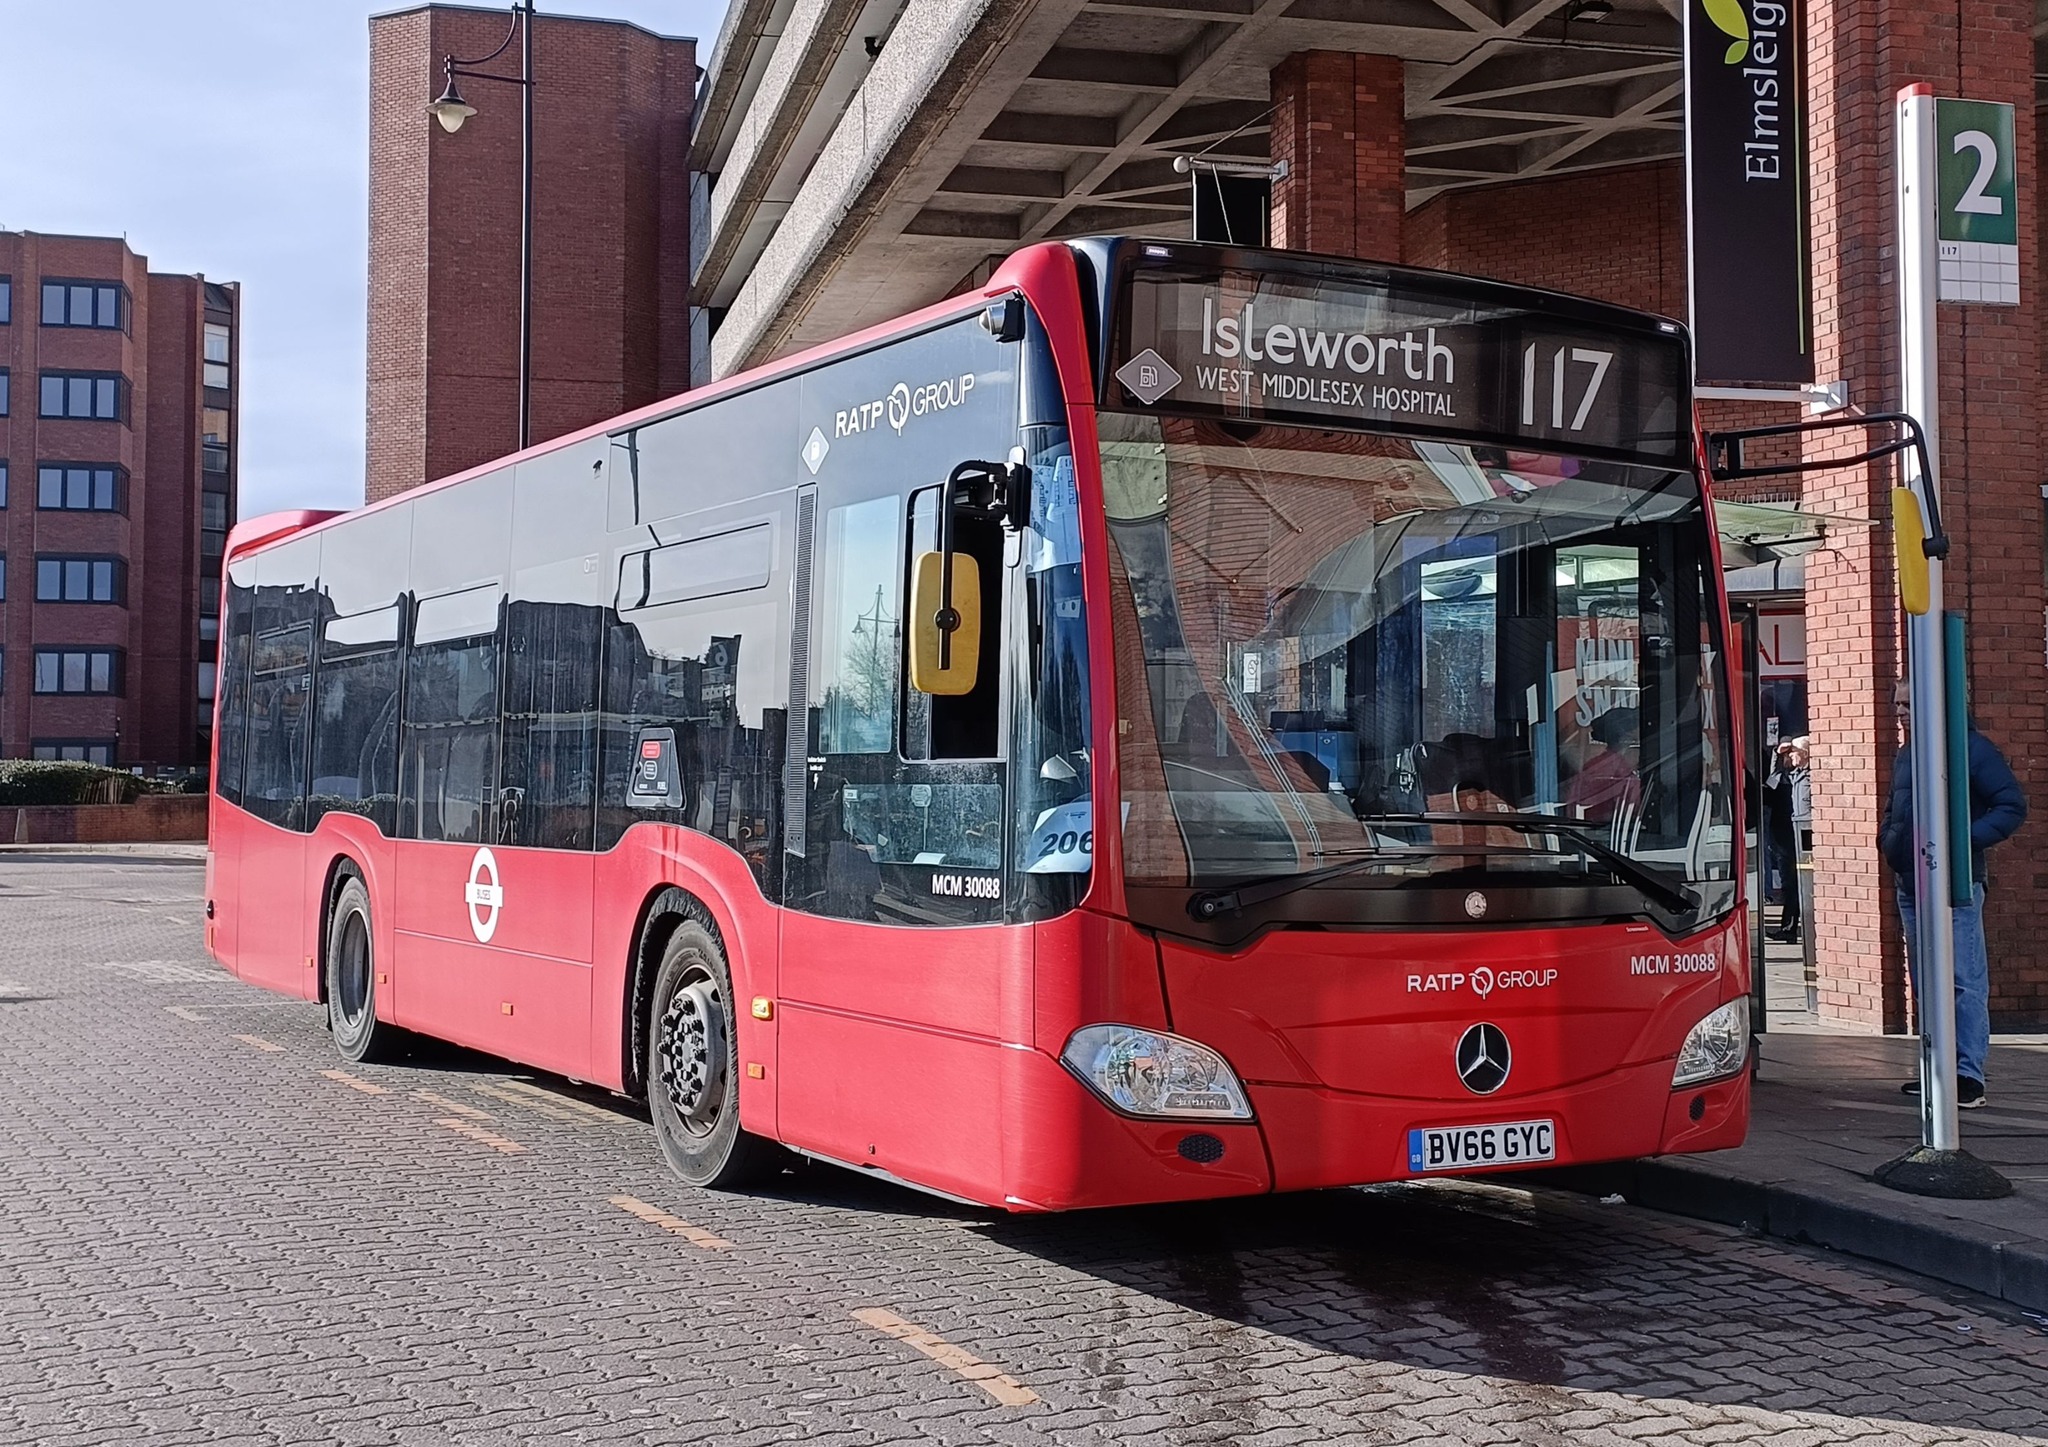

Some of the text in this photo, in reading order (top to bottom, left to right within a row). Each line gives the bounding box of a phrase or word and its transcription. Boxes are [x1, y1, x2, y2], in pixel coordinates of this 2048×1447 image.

[1953, 130, 2003, 215] 2
[1941, 246, 1958, 256] 117
[1201, 297, 1456, 384] Isleworth
[835, 372, 975, 439] RATP GROUP
[1196, 364, 1457, 418] WEST MIDDLESEX HOSPITAL
[1522, 341, 1614, 431] 117
[1575, 637, 1635, 681] MINI
[1037, 829, 1094, 858] 206
[931, 874, 1000, 899] MCM 30088
[1406, 968, 1559, 993] RATP GROUP
[1630, 952, 1716, 976] MCM 30088
[1411, 1153, 1422, 1163] GB
[1428, 1124, 1551, 1165] BV66 GYC
